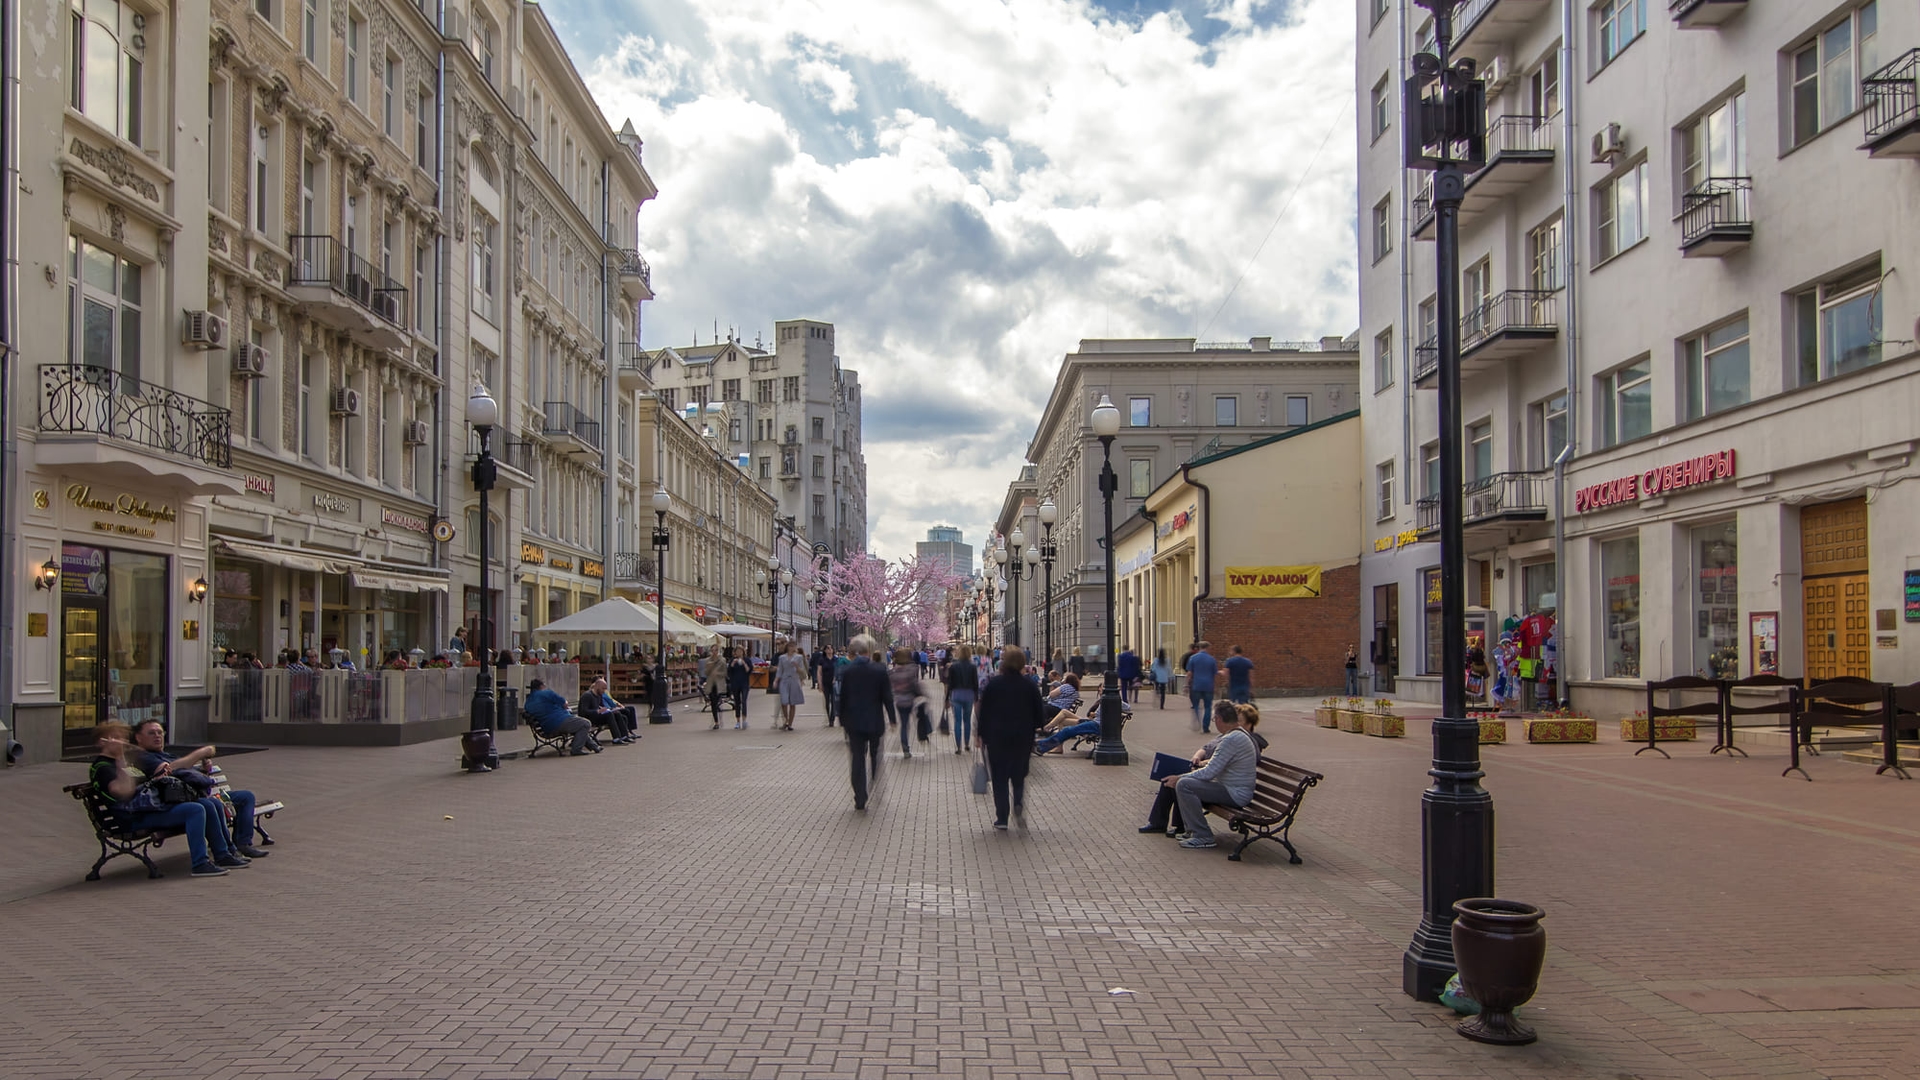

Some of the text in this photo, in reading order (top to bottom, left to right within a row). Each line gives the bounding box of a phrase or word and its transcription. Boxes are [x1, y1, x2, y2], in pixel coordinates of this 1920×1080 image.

[1575, 448, 1736, 513] РУССКИЕ СУВЕНИРЫ
[1229, 574, 1308, 586] ТАТУ ДРАКОН
[1531, 622, 1540, 635] 10
